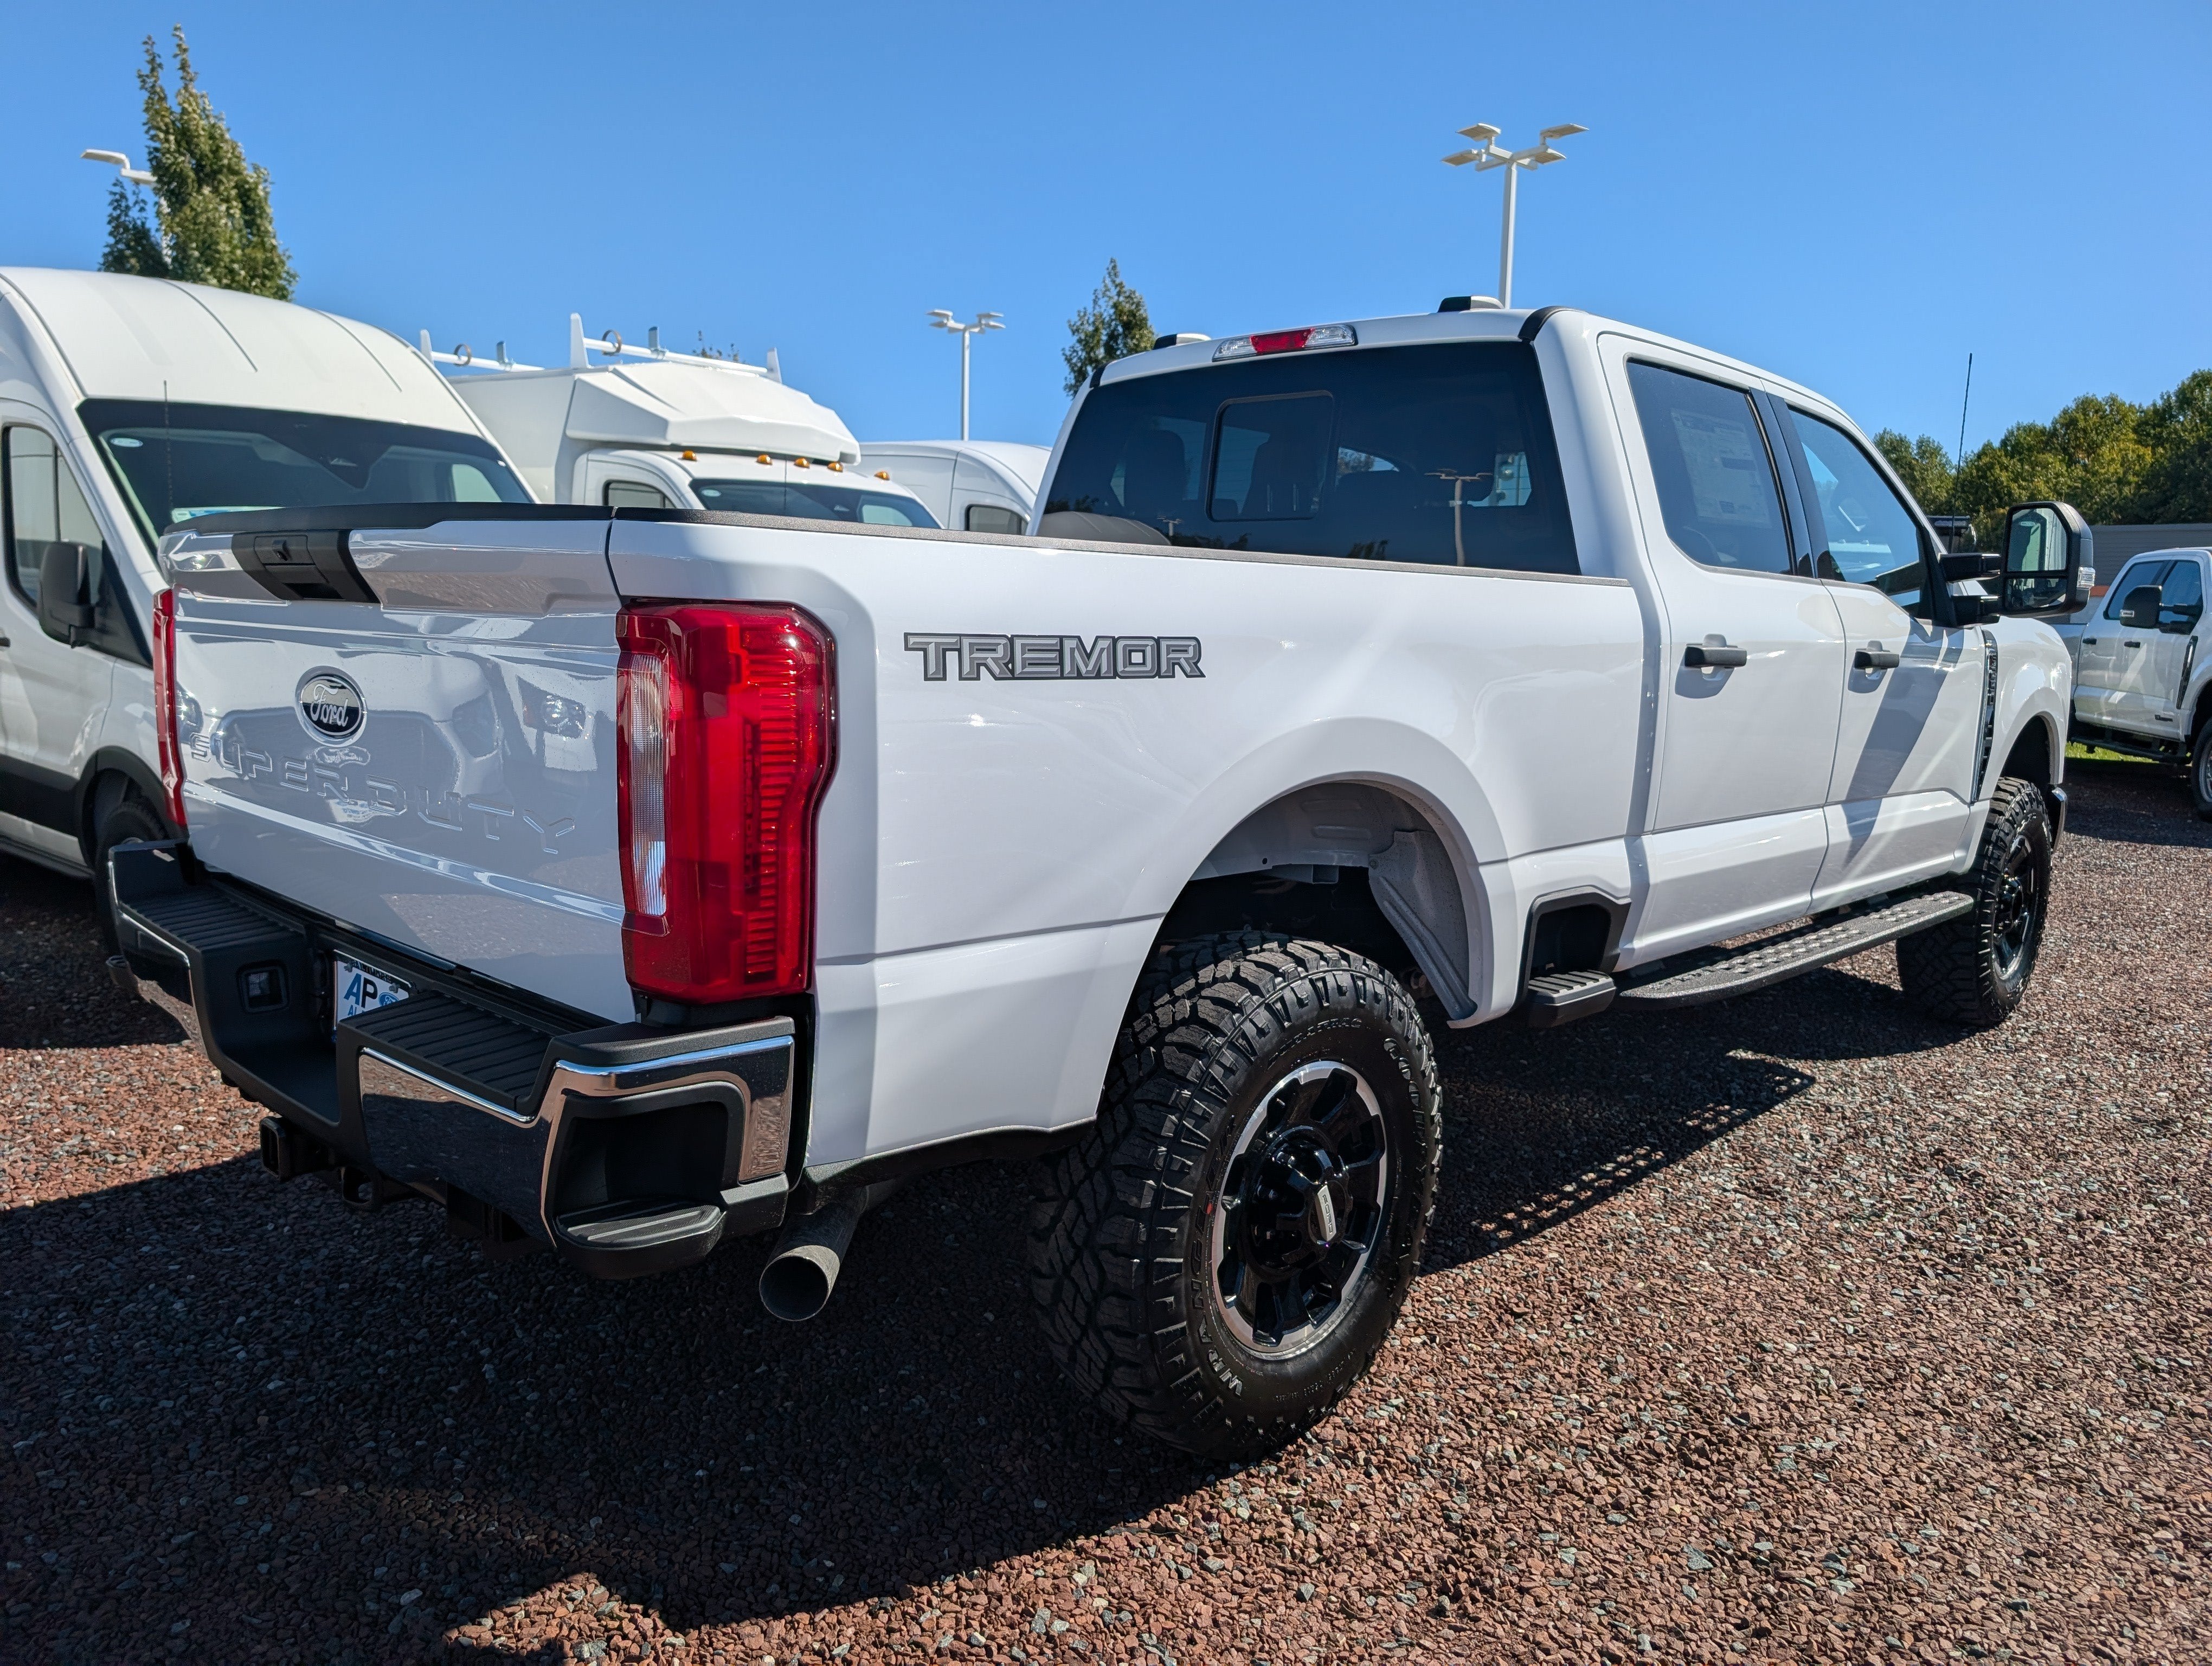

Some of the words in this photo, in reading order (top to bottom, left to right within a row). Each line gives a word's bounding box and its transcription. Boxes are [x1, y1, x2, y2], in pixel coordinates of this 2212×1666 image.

[904, 632, 1206, 681] TREMOR
[310, 683, 349, 727] Ford
[190, 732, 351, 803] SUPER
[365, 773, 576, 855] DUTY
[344, 972, 378, 1009] AP
[1322, 1194, 1333, 1233] FORD
